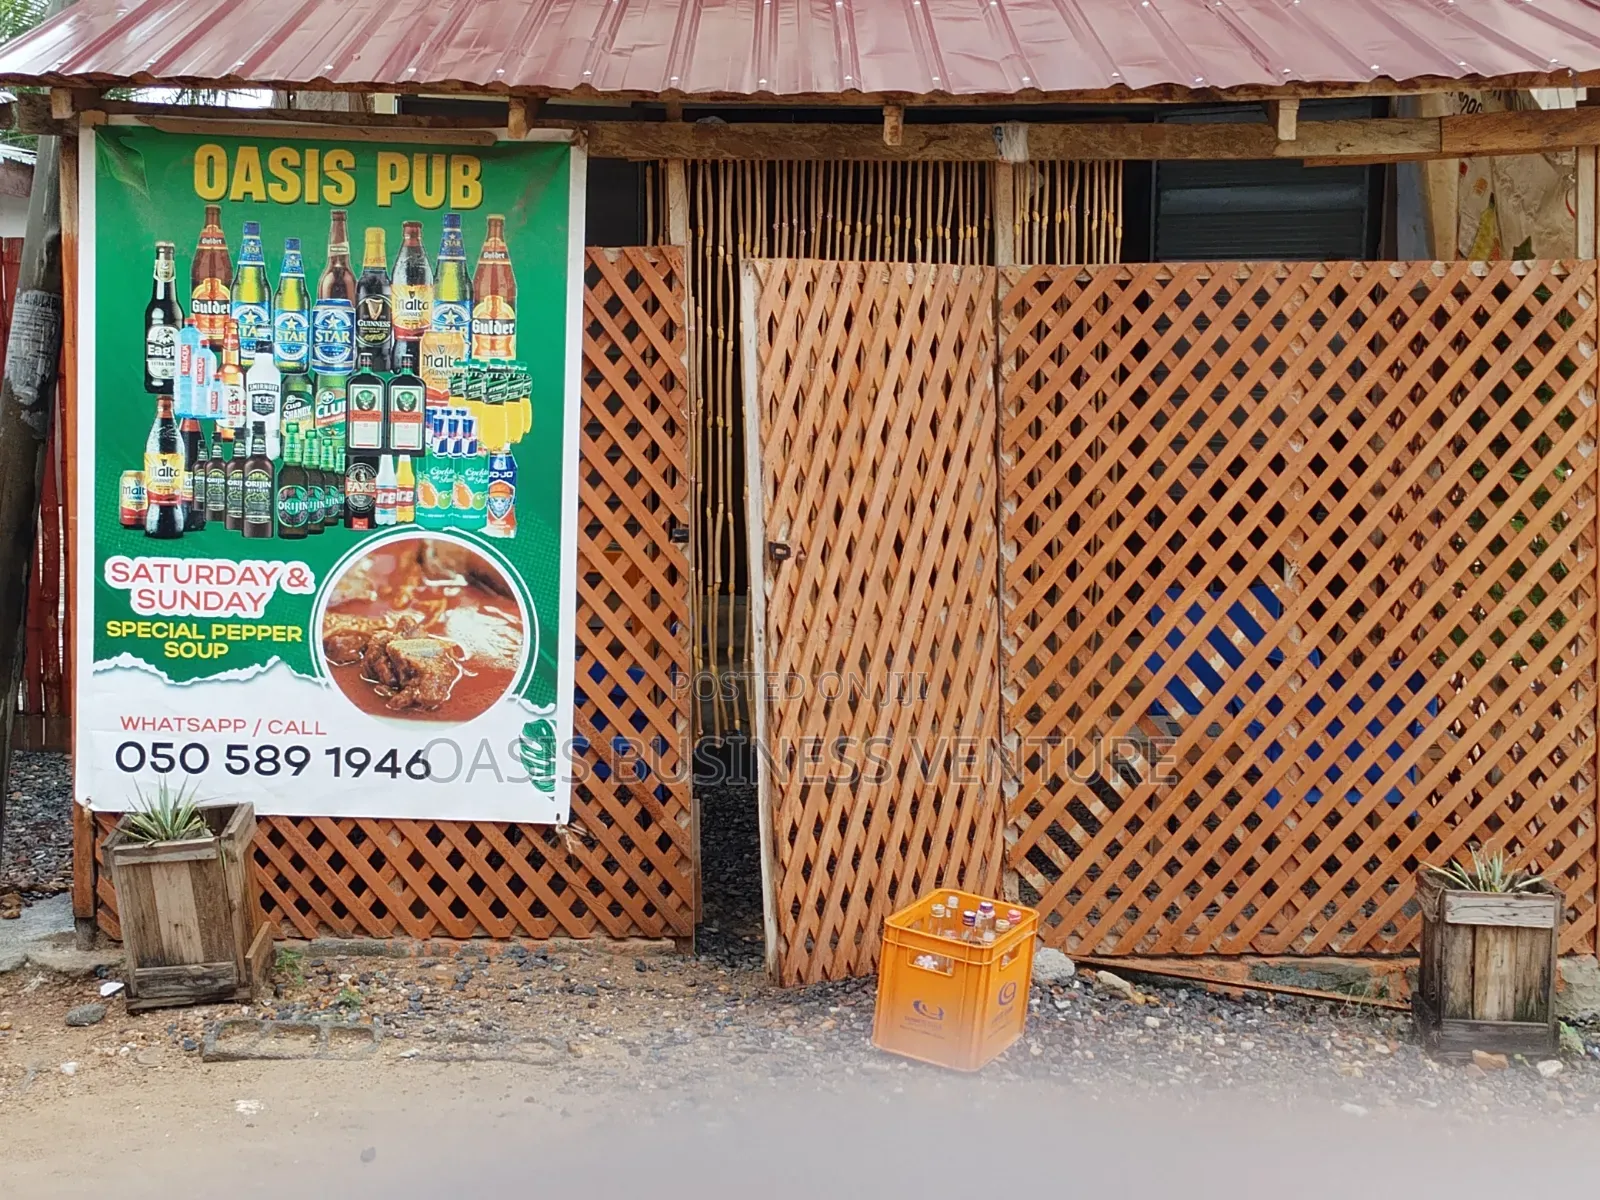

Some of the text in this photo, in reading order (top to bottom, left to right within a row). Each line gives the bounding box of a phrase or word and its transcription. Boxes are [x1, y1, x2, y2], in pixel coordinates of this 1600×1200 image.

[194, 144, 483, 210] OASIS PUB
[396, 299, 429, 311] Malta
[357, 320, 390, 328] GUINNESS
[472, 319, 515, 335] Gulder
[241, 325, 257, 337] TA
[276, 330, 307, 342] STAR
[315, 330, 351, 343] STAR
[147, 344, 175, 359] Eagl
[249, 383, 279, 392] SMIRNOFF
[254, 396, 273, 404] ICE
[286, 402, 302, 411] CLUB
[283, 405, 312, 421] SHANDY
[148, 466, 180, 477] Malta
[227, 479, 242, 487] ORIJ
[244, 480, 272, 489] ORIJIN
[347, 482, 376, 492] FAXE
[122, 485, 147, 496] Malt
[278, 500, 308, 512] ORIJIN
[111, 561, 309, 588] SATURDAY &
[137, 588, 266, 612] SUNDAY
[106, 620, 303, 642] SPECIAL PEPPER
[164, 641, 229, 659] SOUP
[120, 716, 327, 737] WHATSAPP / CALL
[115, 741, 431, 781] 050 589 1946
